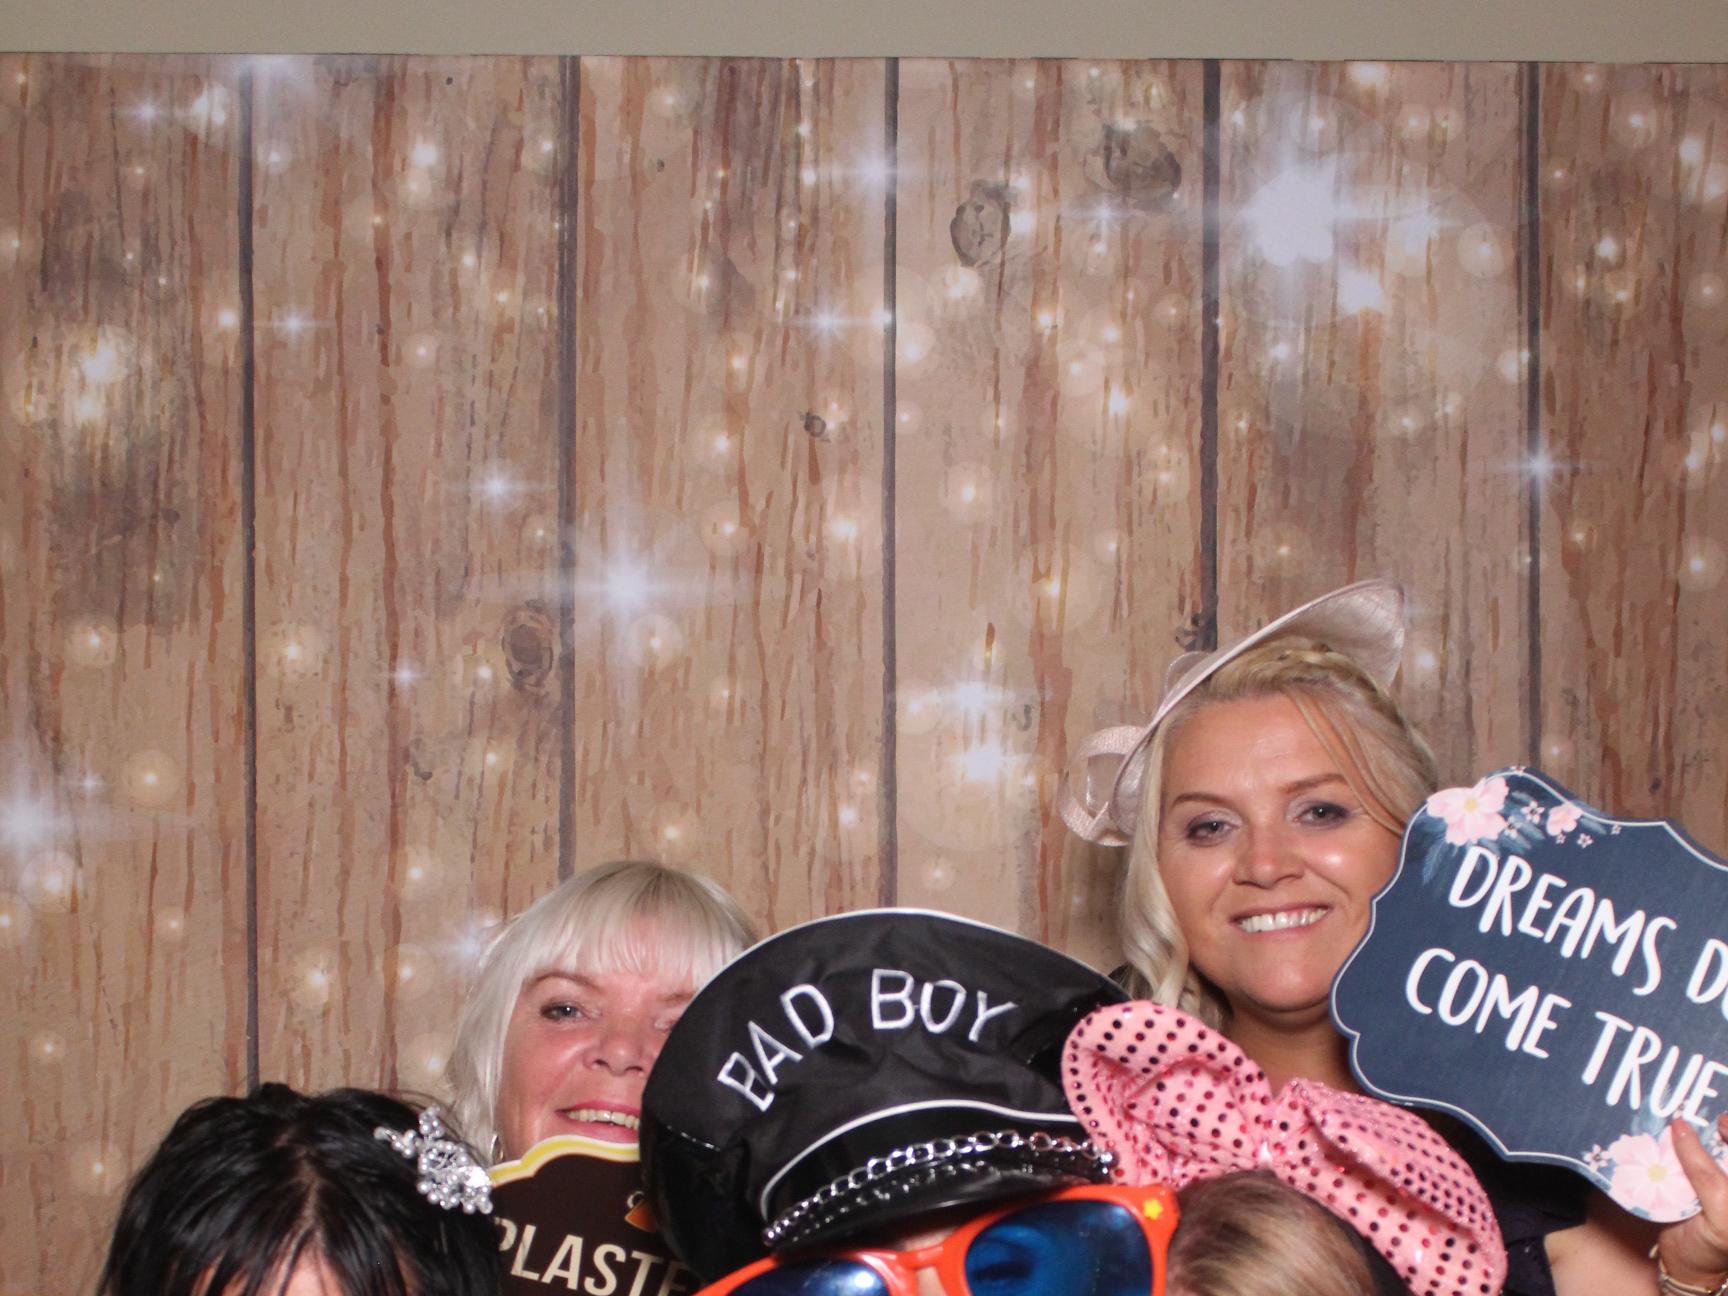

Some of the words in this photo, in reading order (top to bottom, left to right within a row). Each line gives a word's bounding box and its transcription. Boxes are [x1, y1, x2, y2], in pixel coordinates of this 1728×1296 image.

[1449, 845, 1677, 996] DREAMS
[1686, 938, 1728, 1021] D
[717, 984, 834, 1112] BAD
[870, 968, 1018, 1042] BOY
[1405, 948, 1572, 1059] COME
[1581, 1011, 1728, 1127] TRUE
